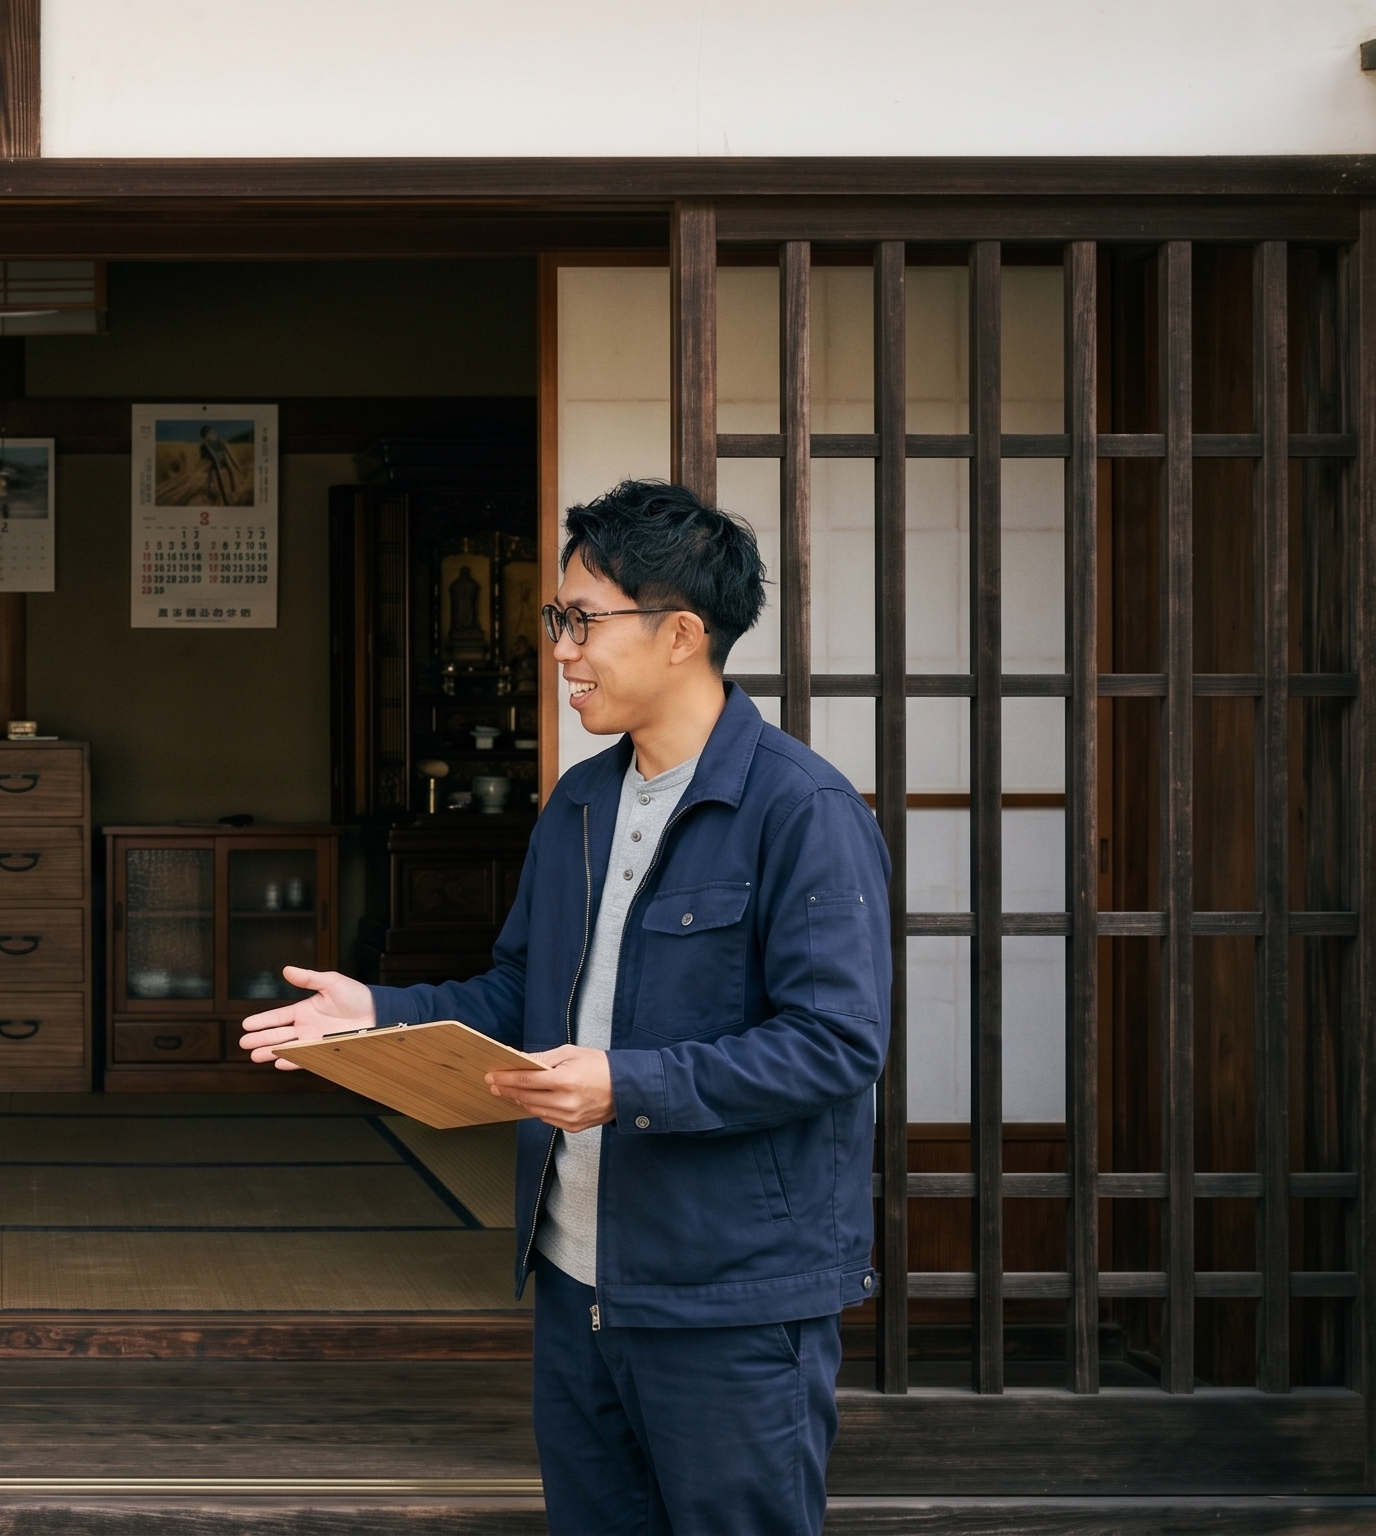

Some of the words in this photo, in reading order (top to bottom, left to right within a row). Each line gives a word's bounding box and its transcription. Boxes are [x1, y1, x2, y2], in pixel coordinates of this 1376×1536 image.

[199, 512, 210, 526] 3
[1, 522, 9, 533] 2
[182, 530, 186, 540] 1
[193, 530, 200, 540] 2
[247, 530, 254, 540] 2
